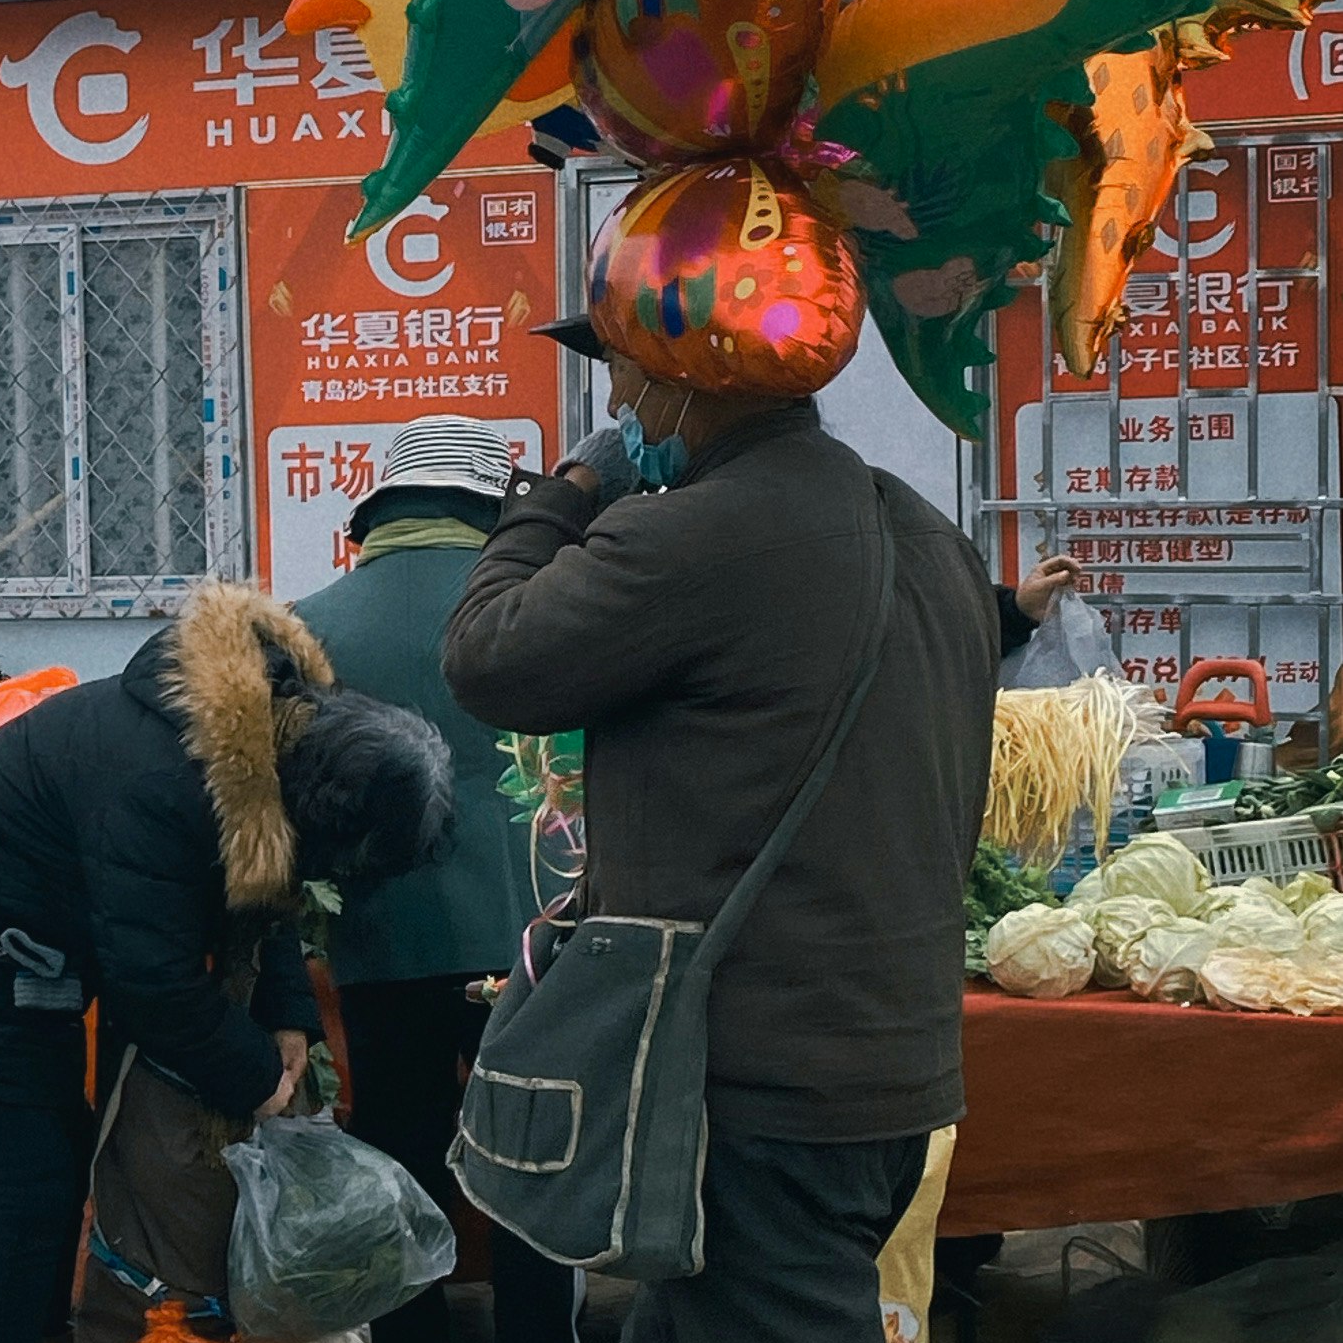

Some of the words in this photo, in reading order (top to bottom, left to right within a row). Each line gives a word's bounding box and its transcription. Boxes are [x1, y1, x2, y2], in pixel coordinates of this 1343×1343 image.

[486, 199, 533, 217] 国有
[486, 221, 533, 238] 银行
[1122, 271, 1294, 316] 夏银行
[301, 306, 505, 353] 华夏银行
[1129, 321, 1180, 338] XIA
[307, 353, 409, 370] HUAXIA
[426, 348, 500, 365] BANK
[301, 373, 510, 403] 青岛沙子口社区支行
